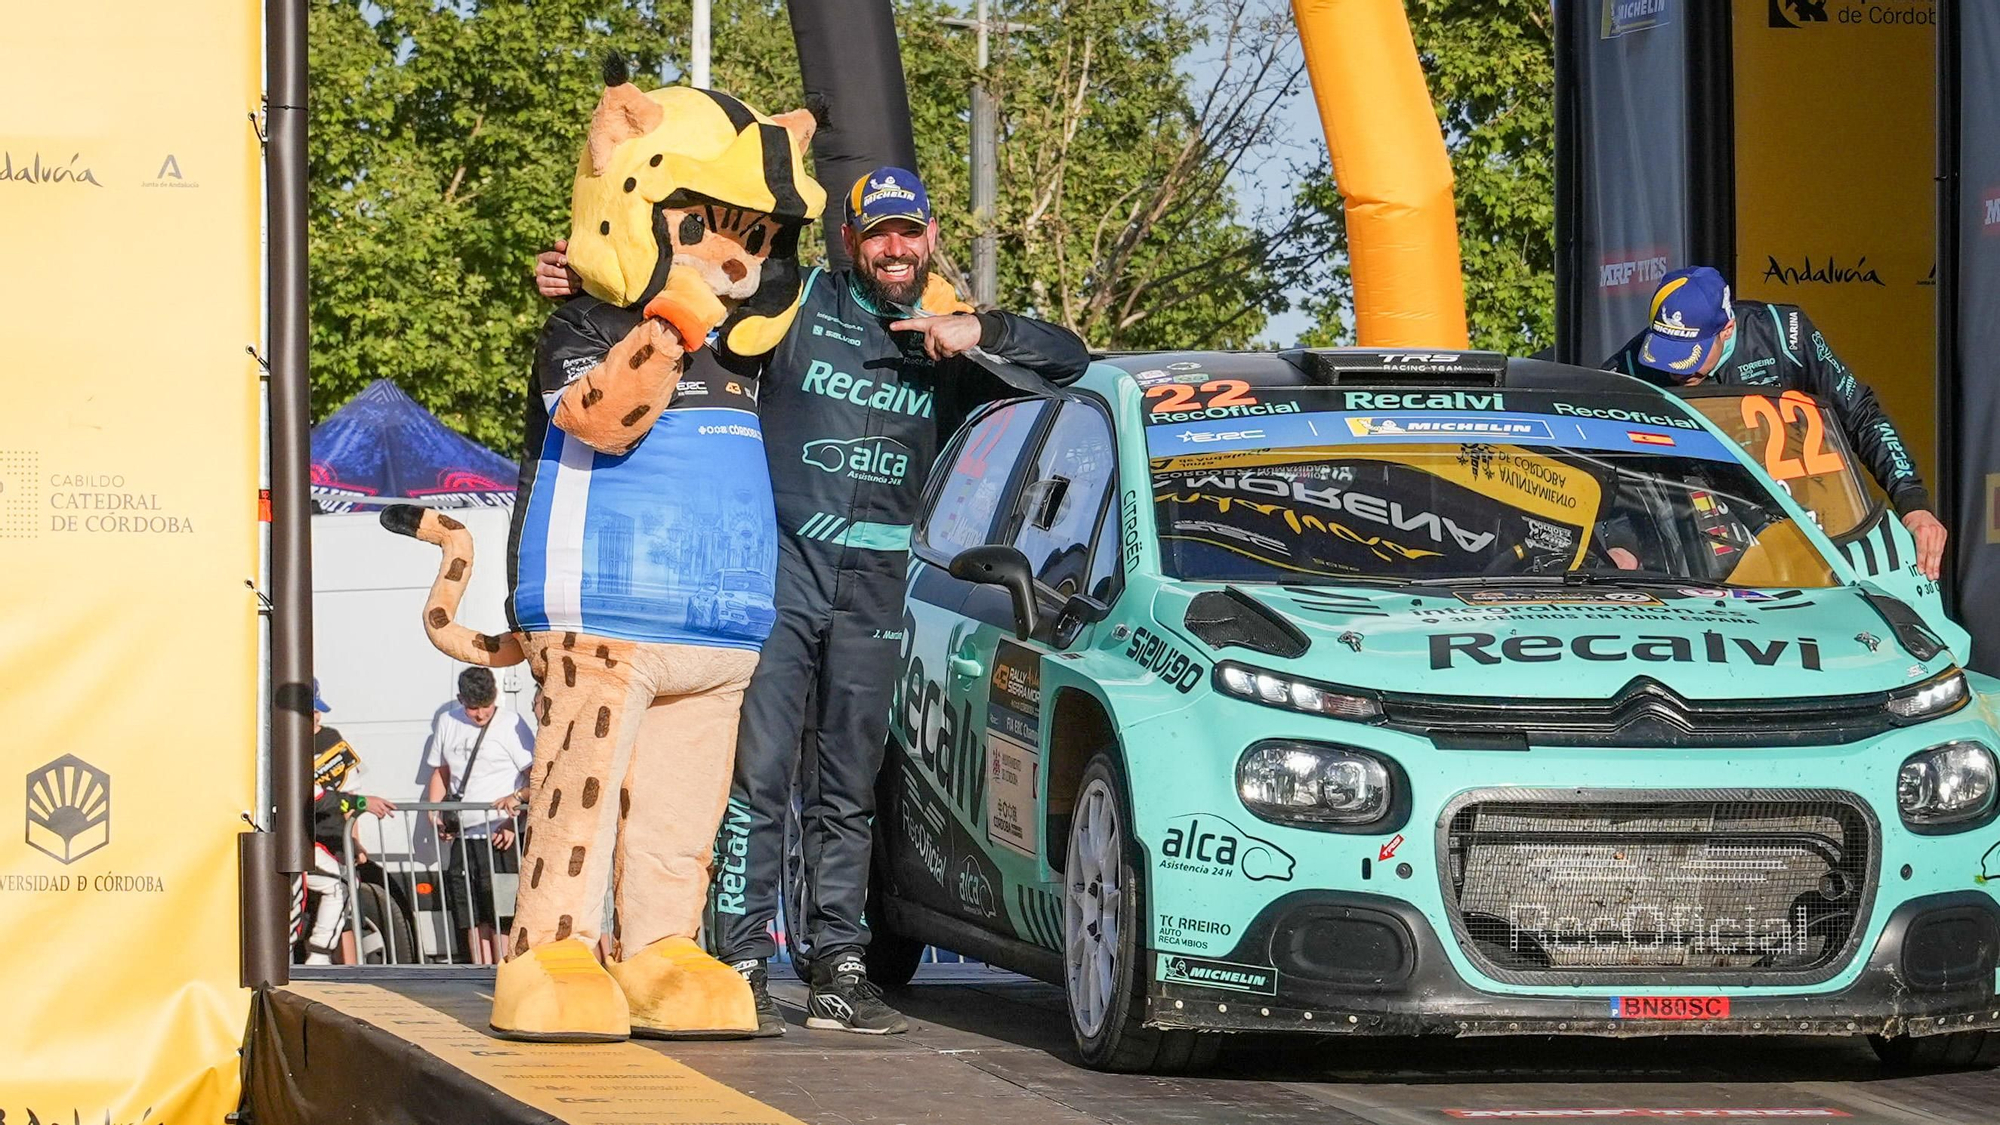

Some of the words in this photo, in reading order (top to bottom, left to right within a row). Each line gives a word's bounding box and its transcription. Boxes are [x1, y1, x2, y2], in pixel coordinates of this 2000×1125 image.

[1838, 7, 1862, 24] de
[1869, 7, 1937, 25] Córdob
[863, 190, 916, 207] MICHELIN
[1763, 255, 1886, 286] Andalucía
[1653, 324, 1699, 339] MICHELIN
[1383, 364, 1427, 372] RACING
[801, 359, 935, 419] Recalvi
[1145, 379, 1258, 413] 22
[1344, 391, 1505, 412] Recalvi
[1150, 401, 1301, 424] RecOficial
[1553, 402, 1700, 430] RecOficial
[1407, 421, 1532, 434] MICHELIN
[1741, 389, 1845, 481] 22
[848, 441, 908, 478] alca
[50, 474, 125, 488] CABILDO
[50, 493, 162, 511] CATEDRAL
[51, 515, 79, 532] DE
[85, 511, 195, 533] CÓRDOBA
[1409, 603, 1748, 618] integralmotion.es
[1450, 615, 1477, 623] 30
[1482, 613, 1577, 622] CENTROS
[1621, 613, 1674, 621] TODA
[1427, 630, 1824, 672] Recalvi
[1010, 667, 1028, 684] RALLY
[903, 799, 947, 888] RecOficial
[1162, 819, 1237, 866] alca
[717, 797, 752, 917] Recalvi
[1159, 860, 1209, 875] Asistencia
[1211, 867, 1225, 876] 24
[94, 871, 164, 893] CÓRDOBA
[959, 862, 979, 905] alca
[1159, 927, 1182, 937] AUTO
[1190, 967, 1266, 986] MICHELIN
[1612, 1009, 1619, 1017] P
[1625, 998, 1721, 1015] BN80SC
